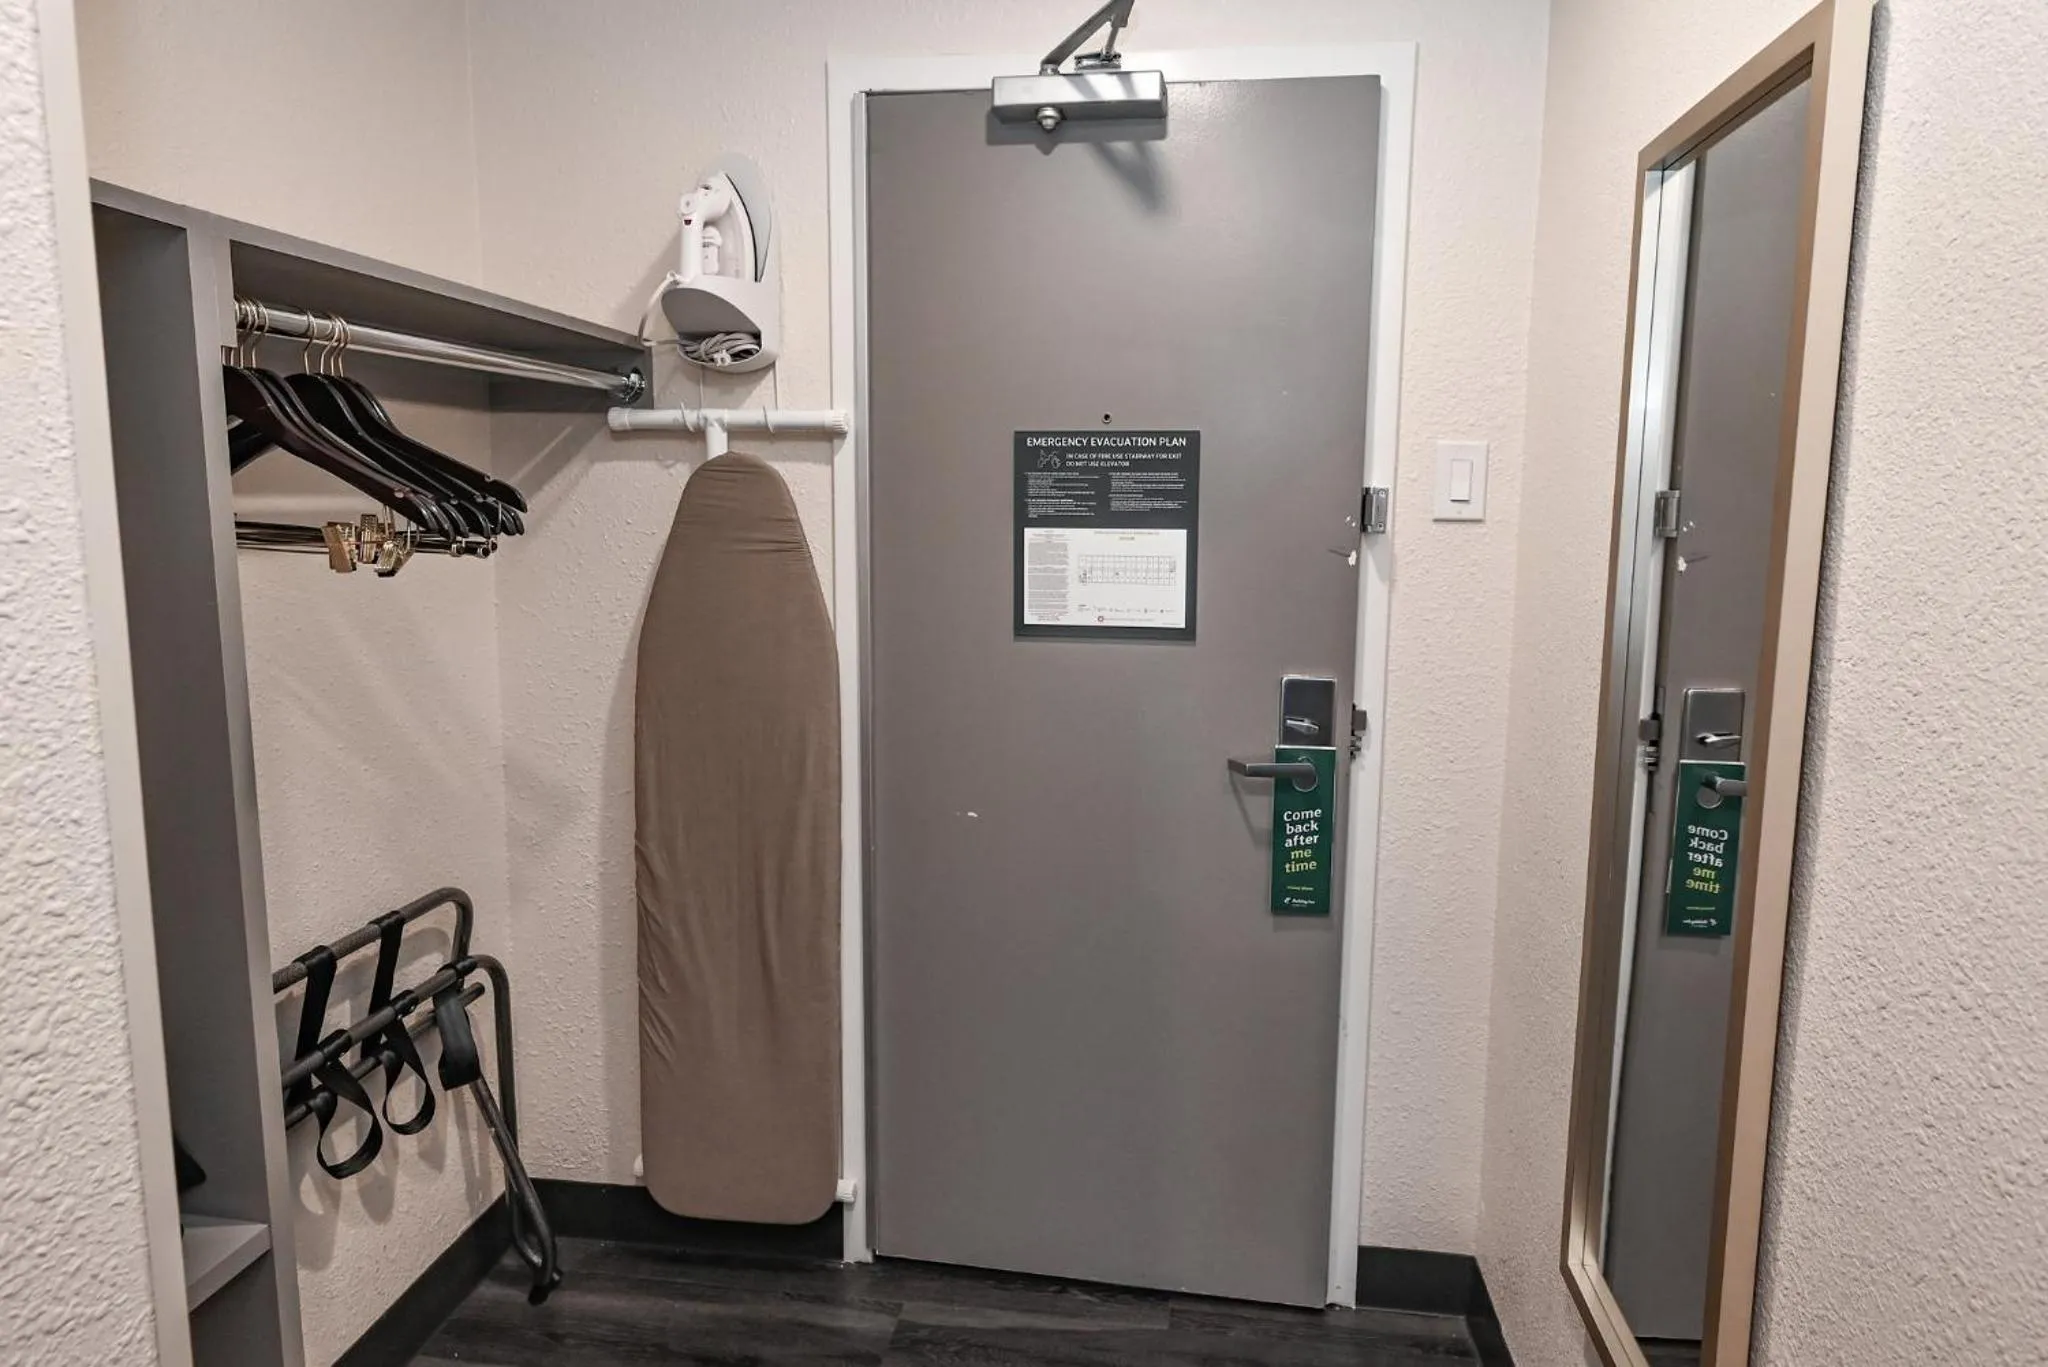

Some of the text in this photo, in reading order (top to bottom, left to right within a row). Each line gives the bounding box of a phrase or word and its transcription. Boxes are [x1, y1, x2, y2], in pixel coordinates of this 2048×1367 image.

[1026, 436, 1186, 447] EMERGENCY EVACUATION PLAN
[1283, 808, 1322, 822] Come
[1285, 819, 1319, 835] back
[1284, 834, 1319, 848] after
[1291, 848, 1312, 859] me
[1285, 860, 1317, 873] time
